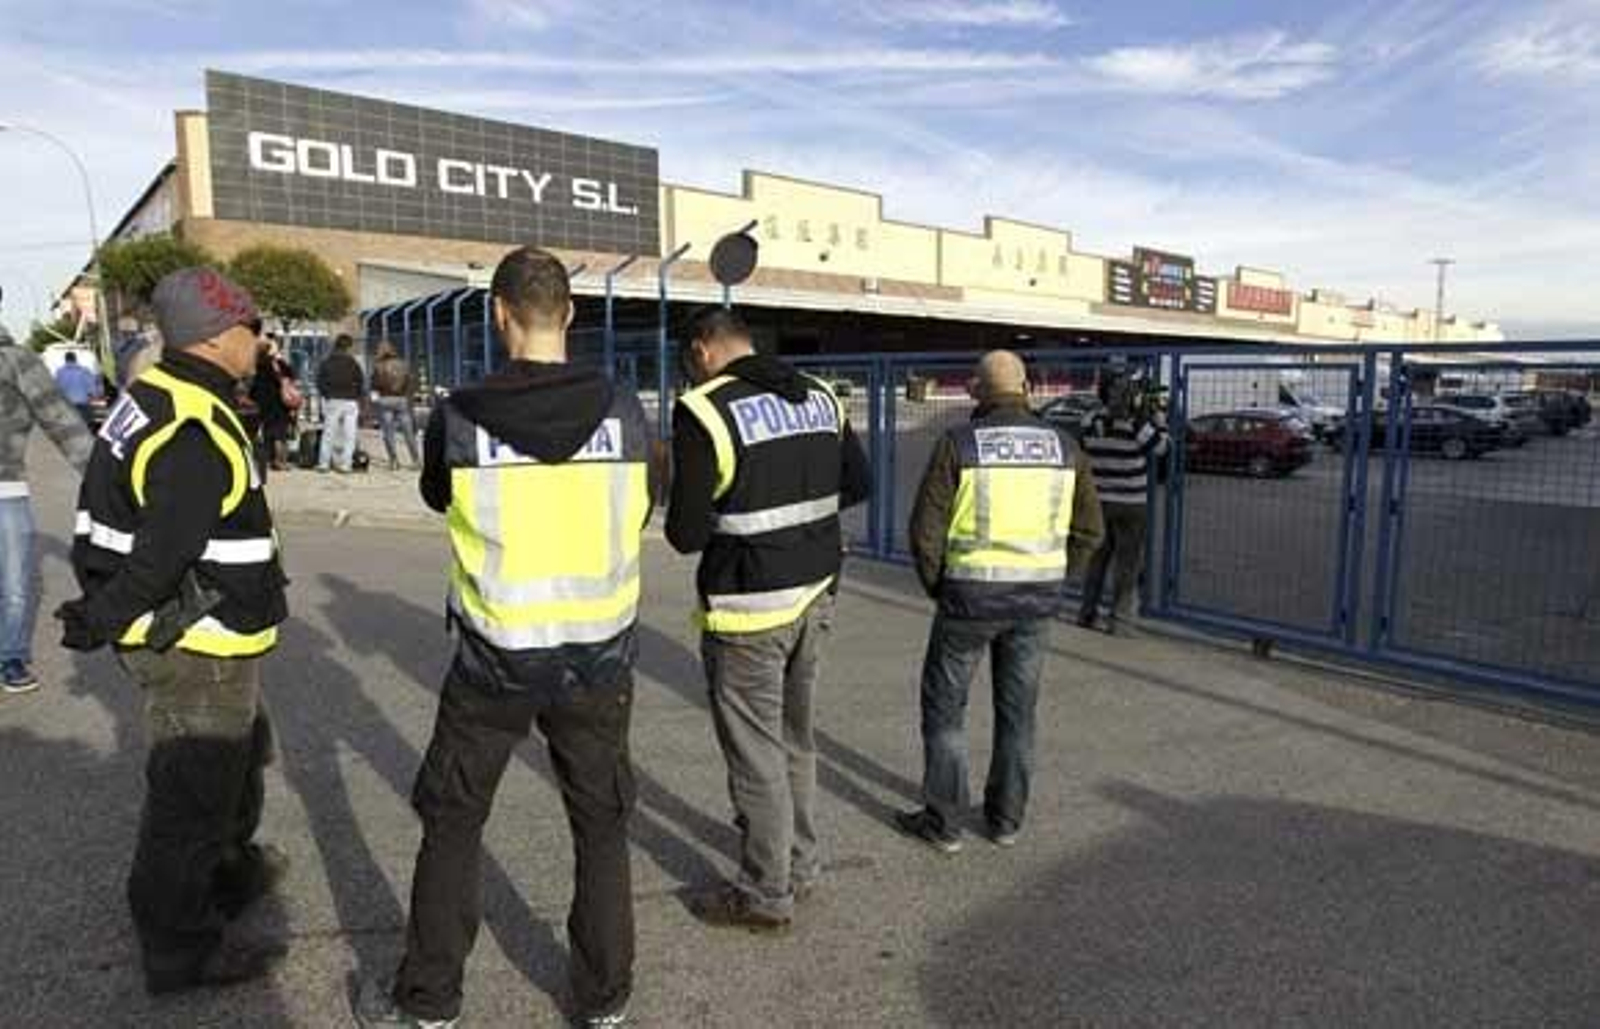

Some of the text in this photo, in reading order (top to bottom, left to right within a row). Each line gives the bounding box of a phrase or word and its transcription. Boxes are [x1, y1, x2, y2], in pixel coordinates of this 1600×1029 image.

[248, 131, 639, 215] GOLD CITY S.L.
